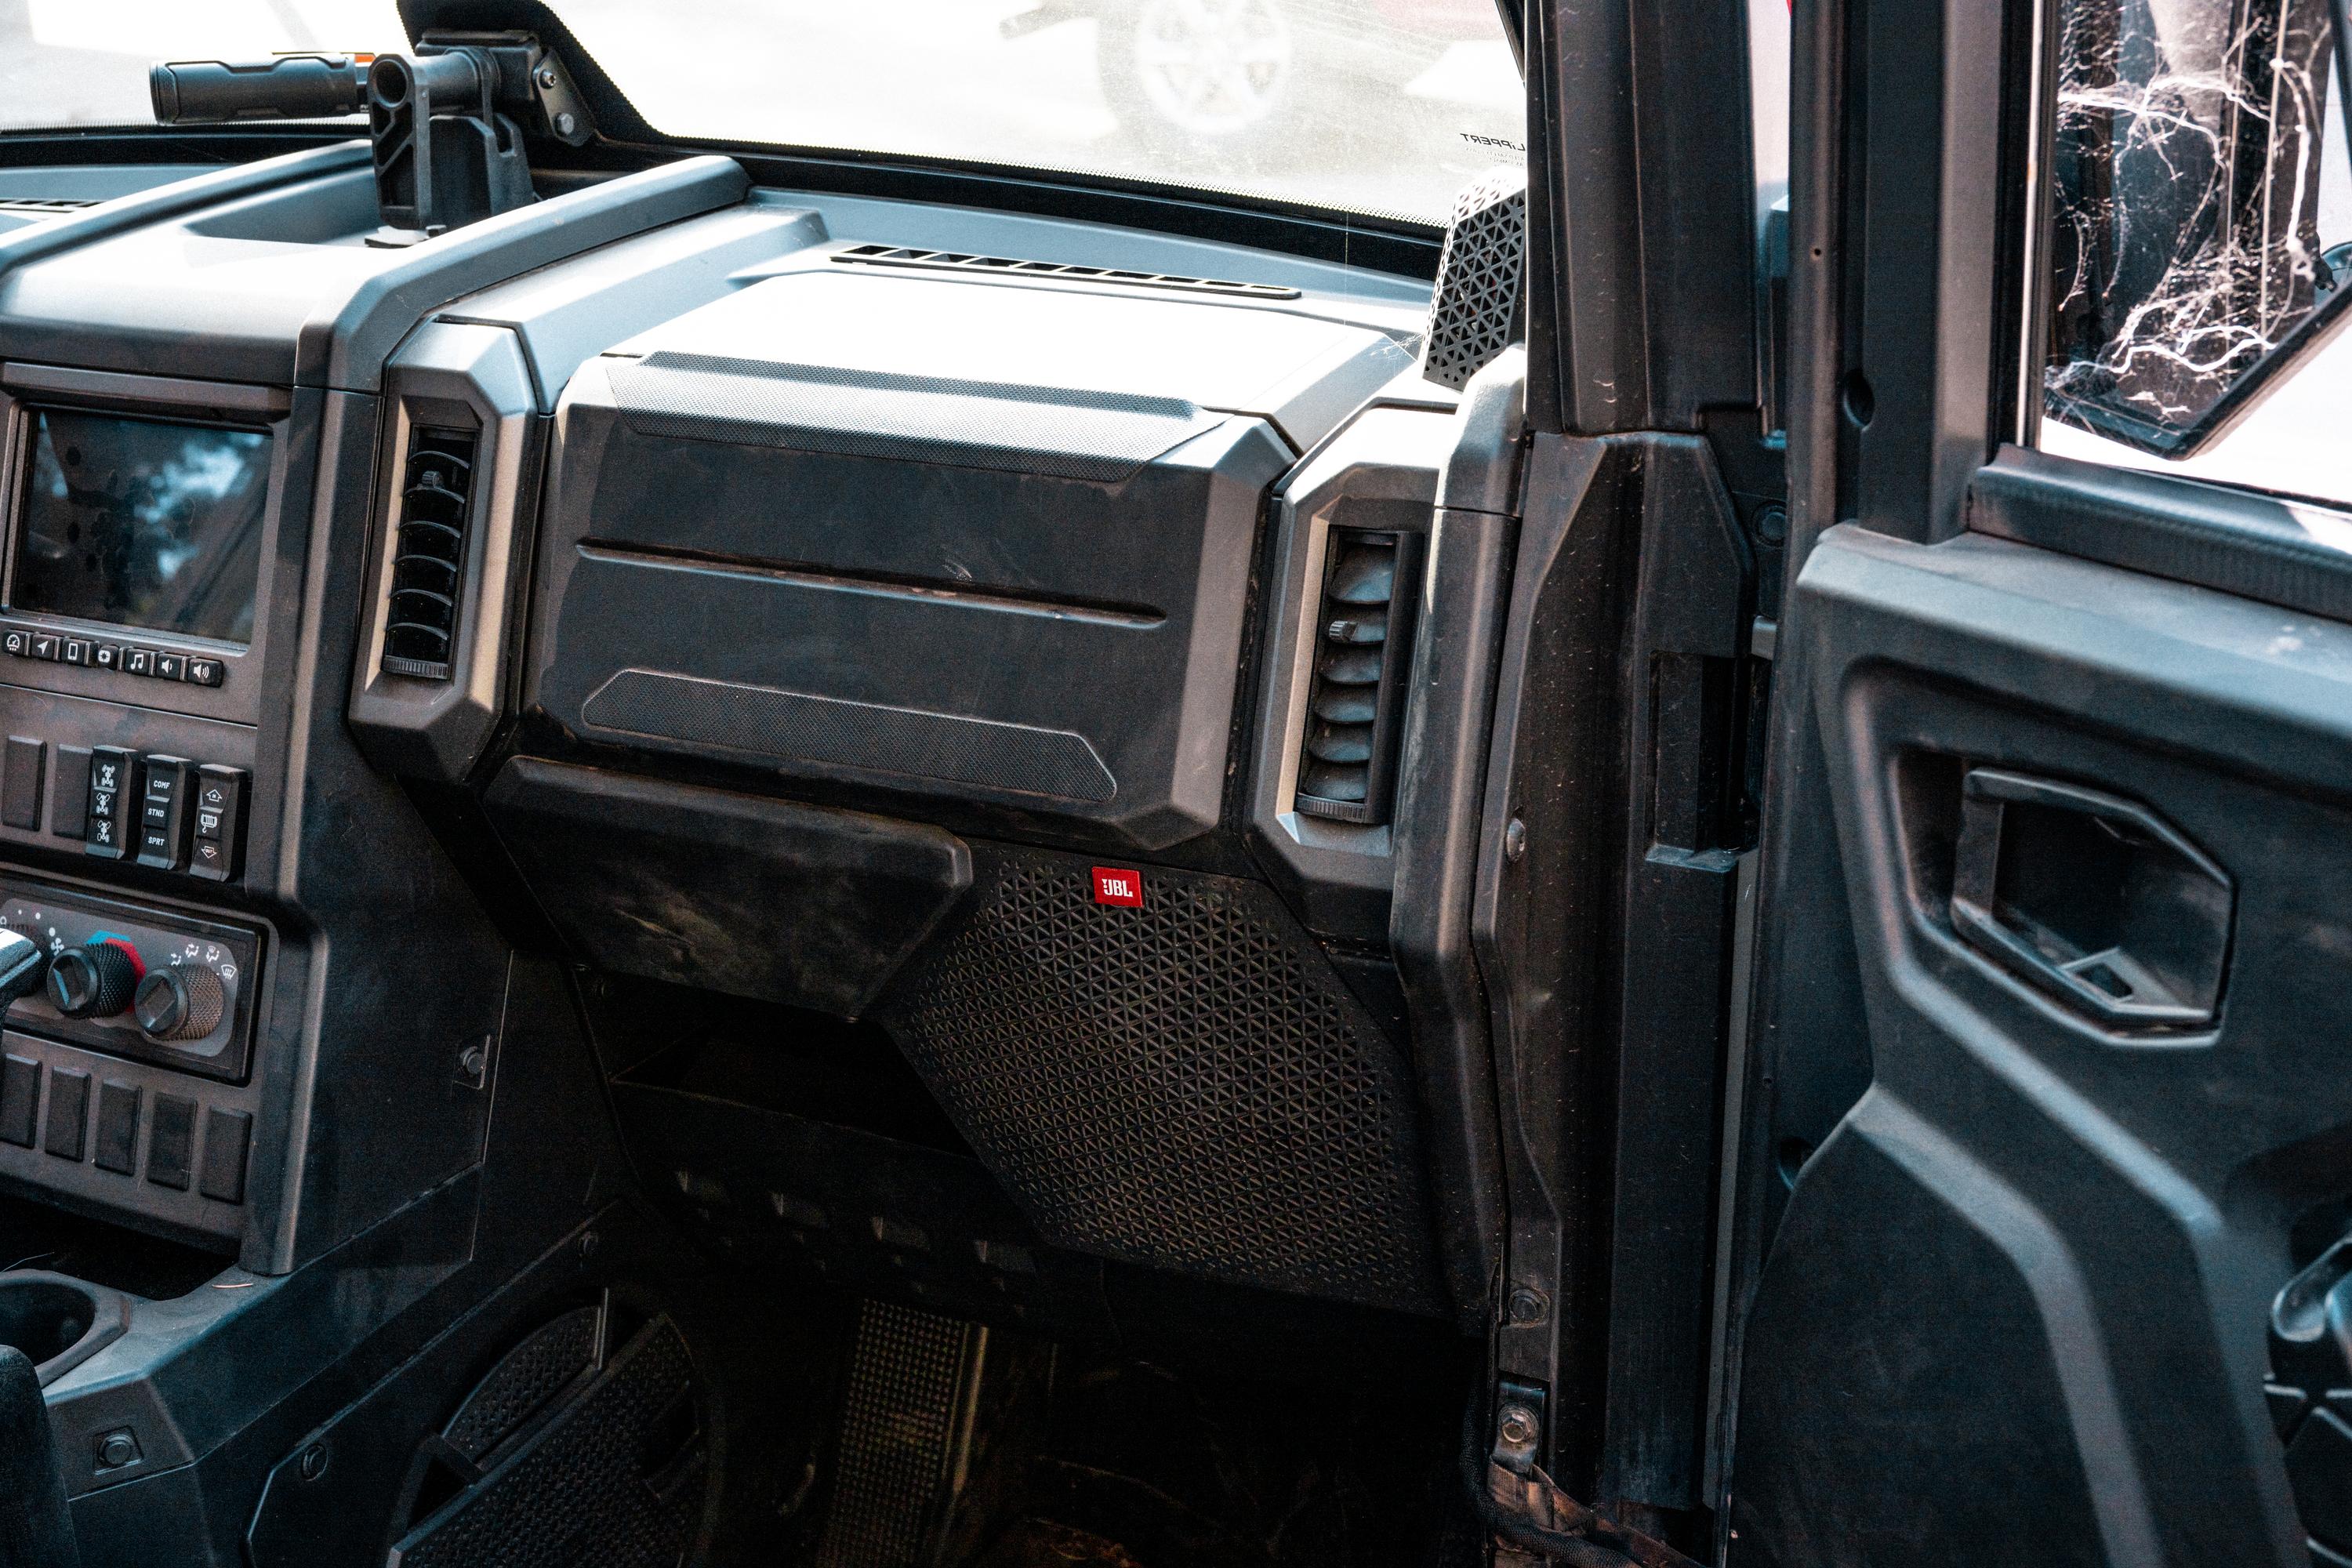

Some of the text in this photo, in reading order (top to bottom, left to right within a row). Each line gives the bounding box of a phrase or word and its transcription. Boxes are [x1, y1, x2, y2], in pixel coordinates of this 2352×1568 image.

[153, 780, 170, 789] COMF
[147, 808, 165, 817] STND
[147, 837, 165, 846] SPRT
[1102, 878, 1134, 897] JBL
